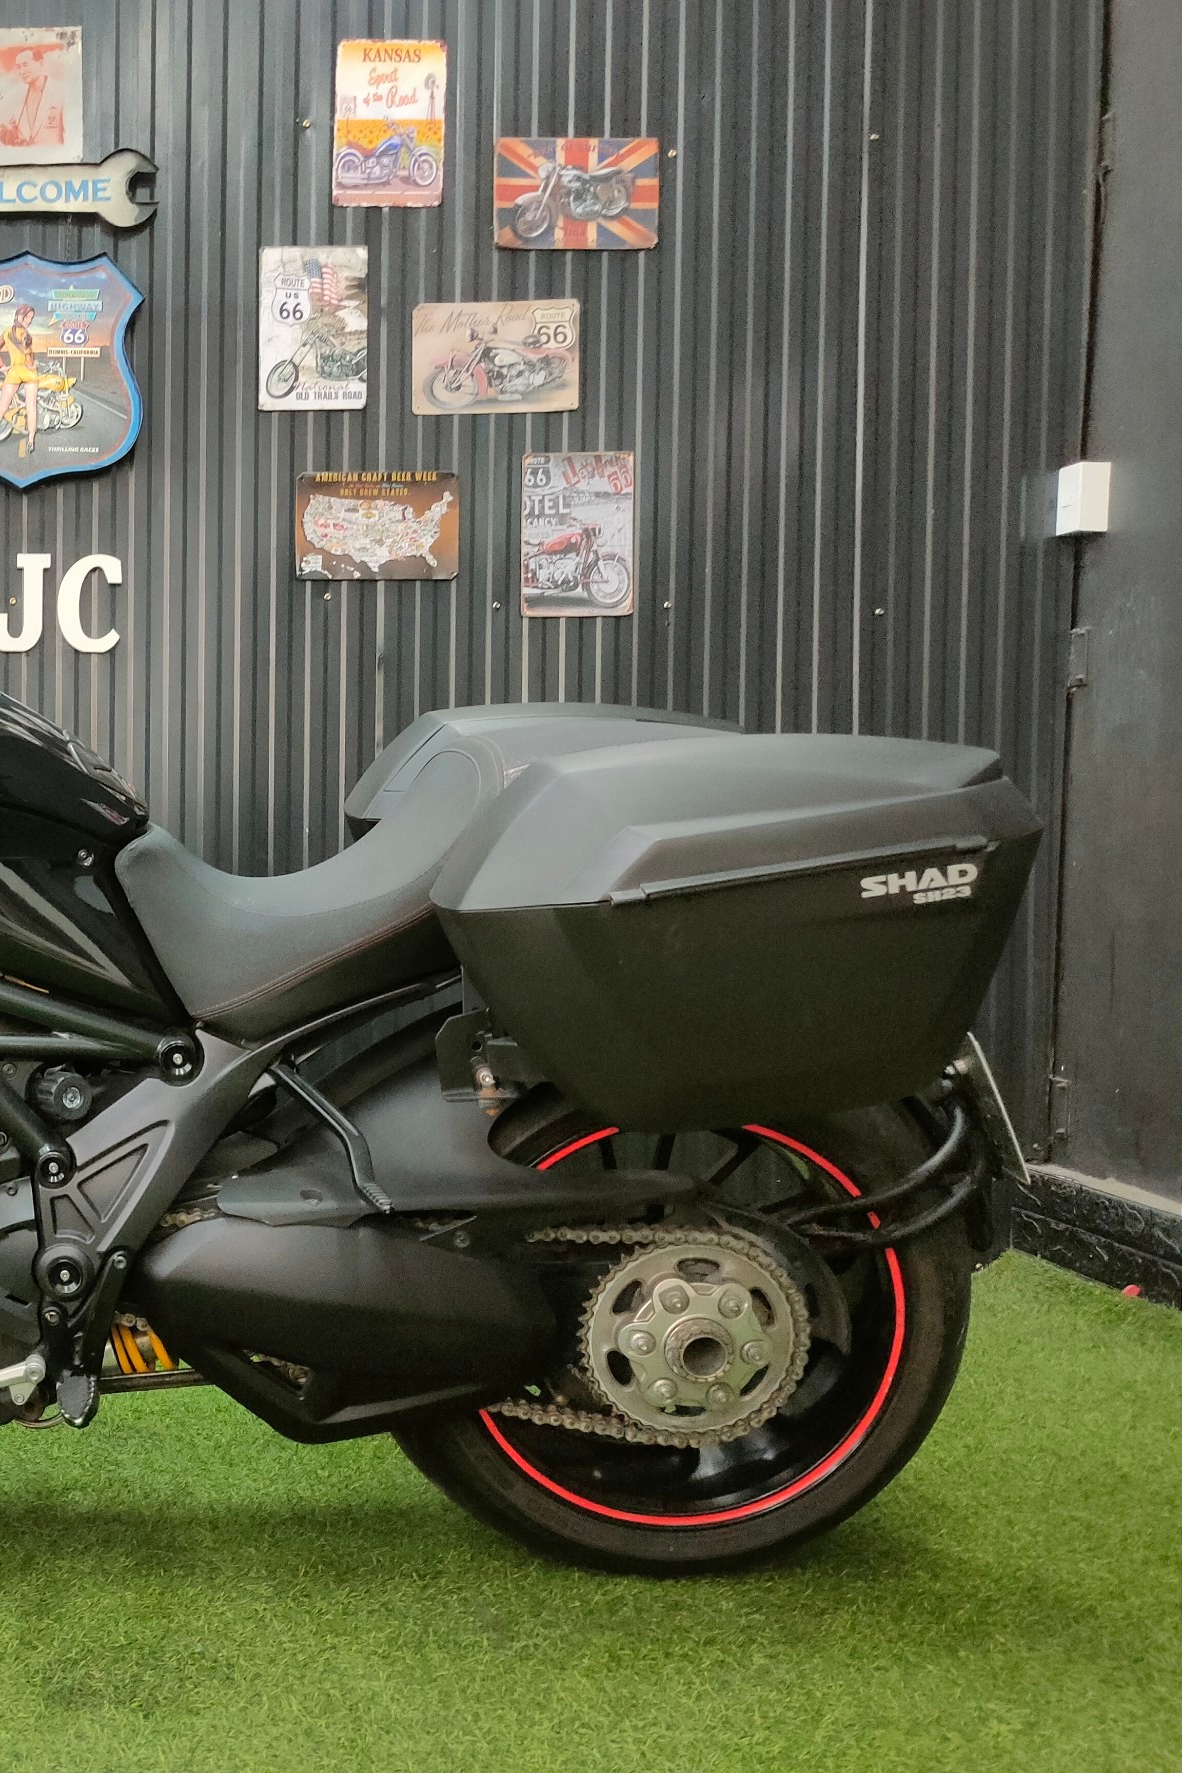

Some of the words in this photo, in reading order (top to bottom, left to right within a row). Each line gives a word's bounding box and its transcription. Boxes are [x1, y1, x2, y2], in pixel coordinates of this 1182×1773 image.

[363, 47, 422, 63] KANSAS
[386, 85, 419, 109] Road
[281, 278, 305, 288] ROUTE
[279, 301, 304, 321] 66
[540, 312, 566, 320] ROUTE
[63, 329, 85, 344] 66
[536, 324, 568, 345] 66
[296, 391, 309, 400] OLD
[342, 391, 363, 400] ROAD
[415, 471, 438, 482] WEEK
[525, 468, 547, 486] 66
[860, 863, 978, 898] SHAD
[913, 885, 972, 904] SH23
